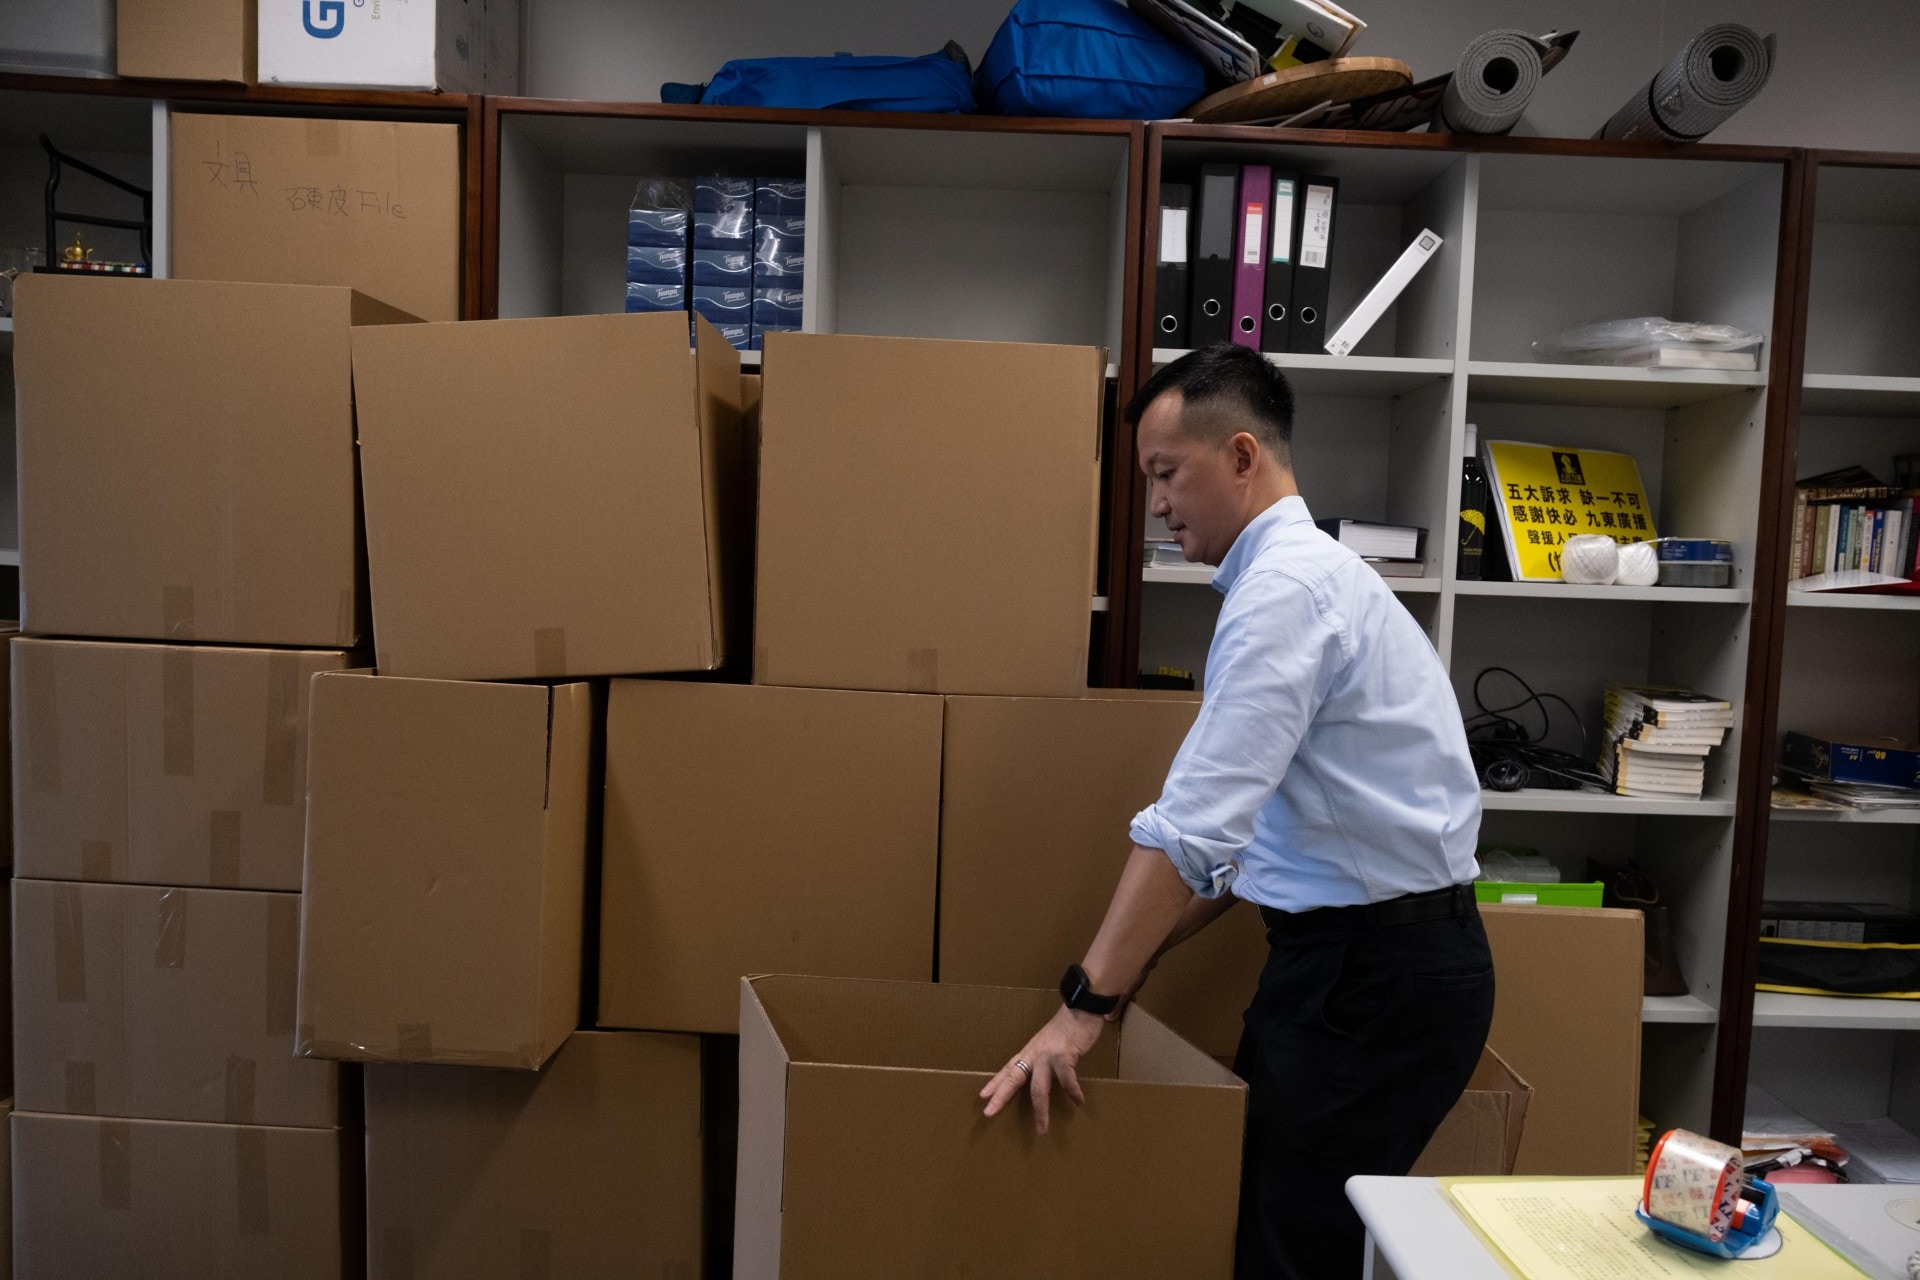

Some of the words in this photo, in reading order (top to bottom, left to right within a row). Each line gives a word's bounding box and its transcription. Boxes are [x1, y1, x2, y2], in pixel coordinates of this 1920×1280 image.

[202, 140, 259, 198] 文具
[283, 185, 349, 217] 硬皮
[356, 191, 407, 219] File
[656, 288, 679, 299] Tempo
[723, 291, 746, 302] Tempo
[721, 327, 744, 338] Tempo
[1506, 483, 1572, 505] 五大訴求
[1579, 488, 1641, 510] 缺一不可
[1513, 505, 1577, 526] 感謝快必
[1586, 510, 1648, 531] 九東廣播
[1874, 750, 1887, 760] 80
